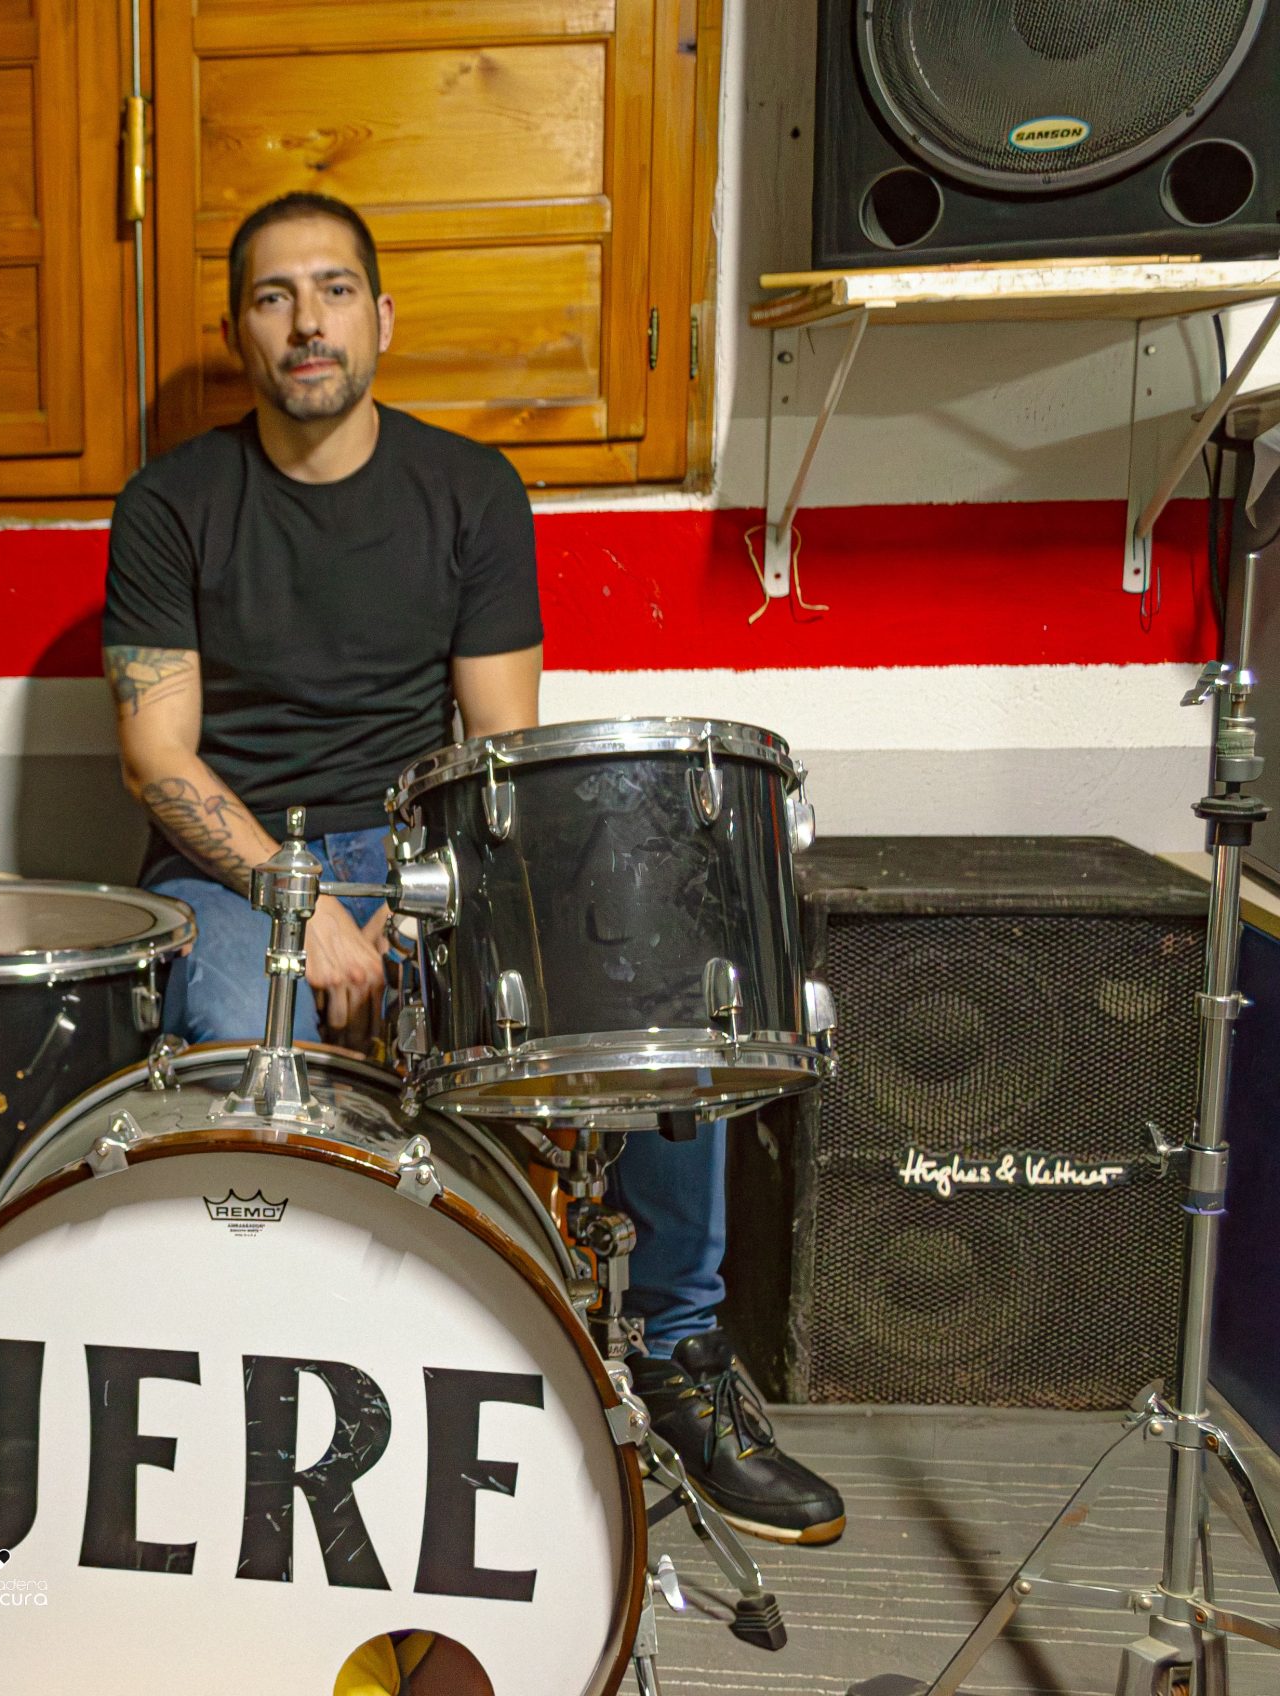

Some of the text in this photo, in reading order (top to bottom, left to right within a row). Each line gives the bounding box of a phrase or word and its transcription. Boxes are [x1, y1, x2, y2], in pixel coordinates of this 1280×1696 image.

[1015, 126, 1084, 141] SAMSON
[899, 1148, 991, 1197] Hughes
[995, 1154, 1017, 1183] &
[215, 1206, 277, 1218] REMO
